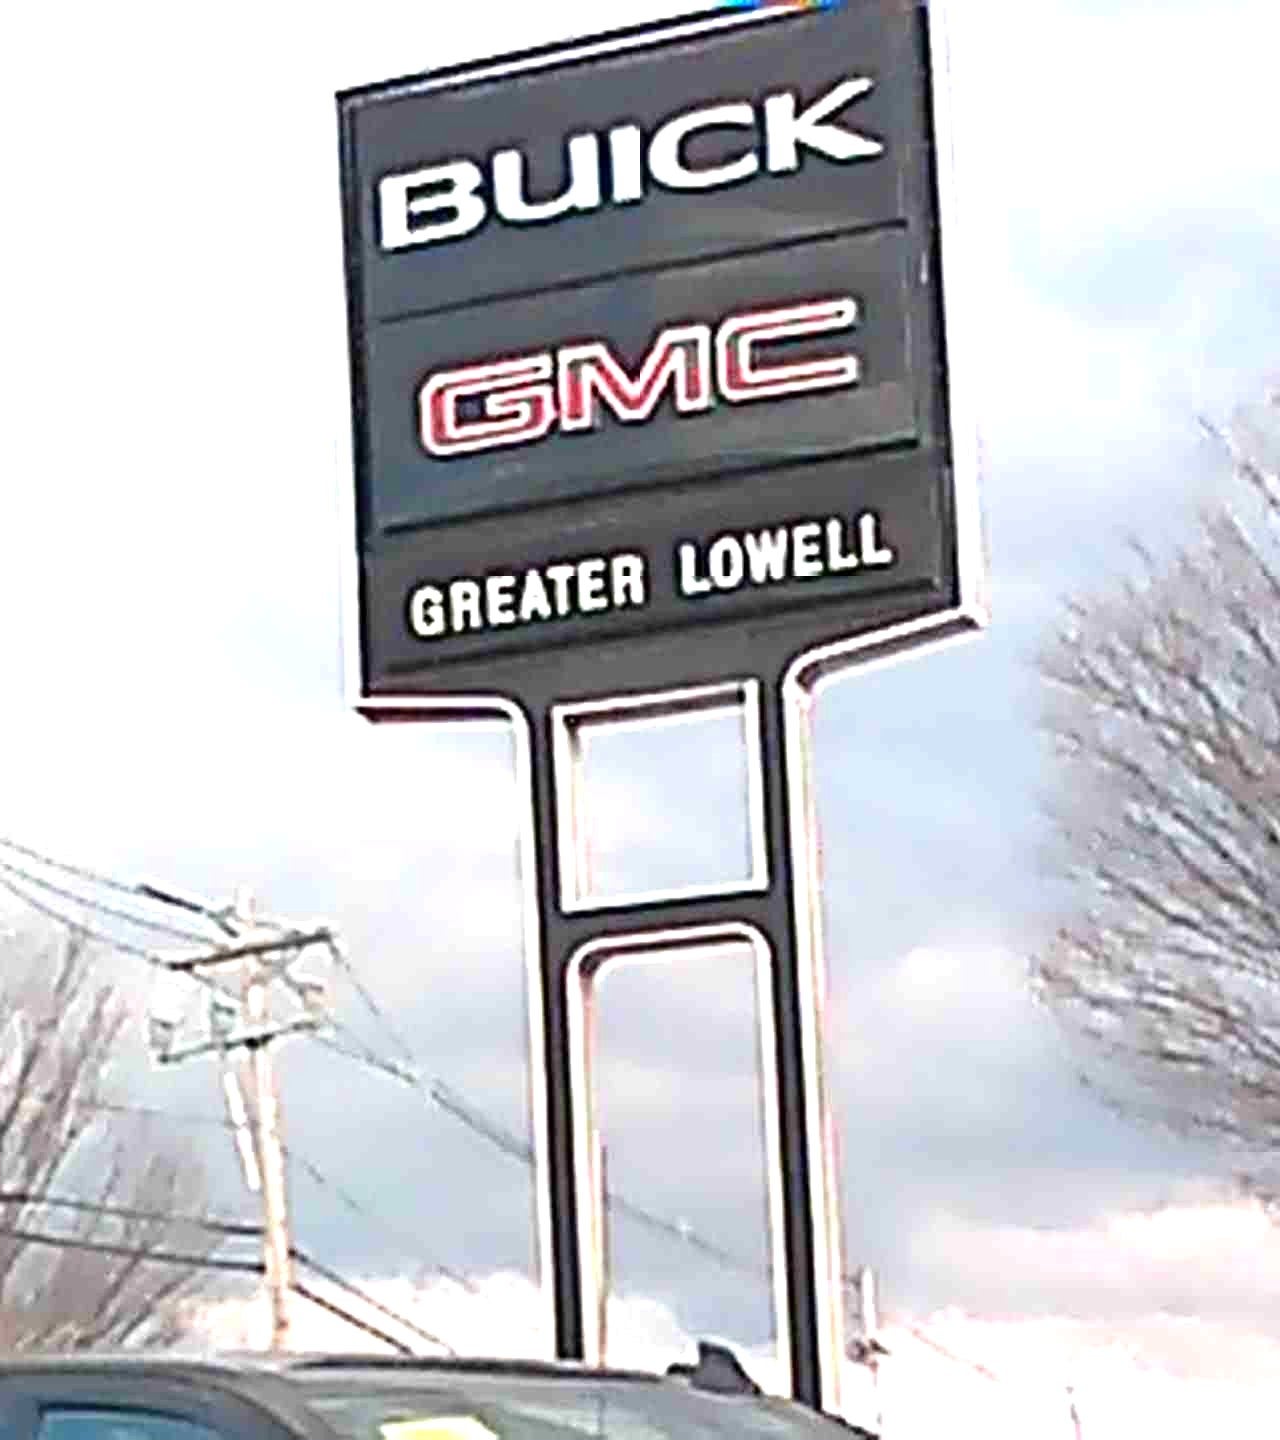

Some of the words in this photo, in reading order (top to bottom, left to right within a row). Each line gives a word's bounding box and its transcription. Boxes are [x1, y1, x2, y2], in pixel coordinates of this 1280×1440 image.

[378, 77, 884, 250] BUICK
[421, 299, 859, 456] GMC
[410, 554, 645, 637] GREATER
[678, 513, 893, 595] LOWELL
